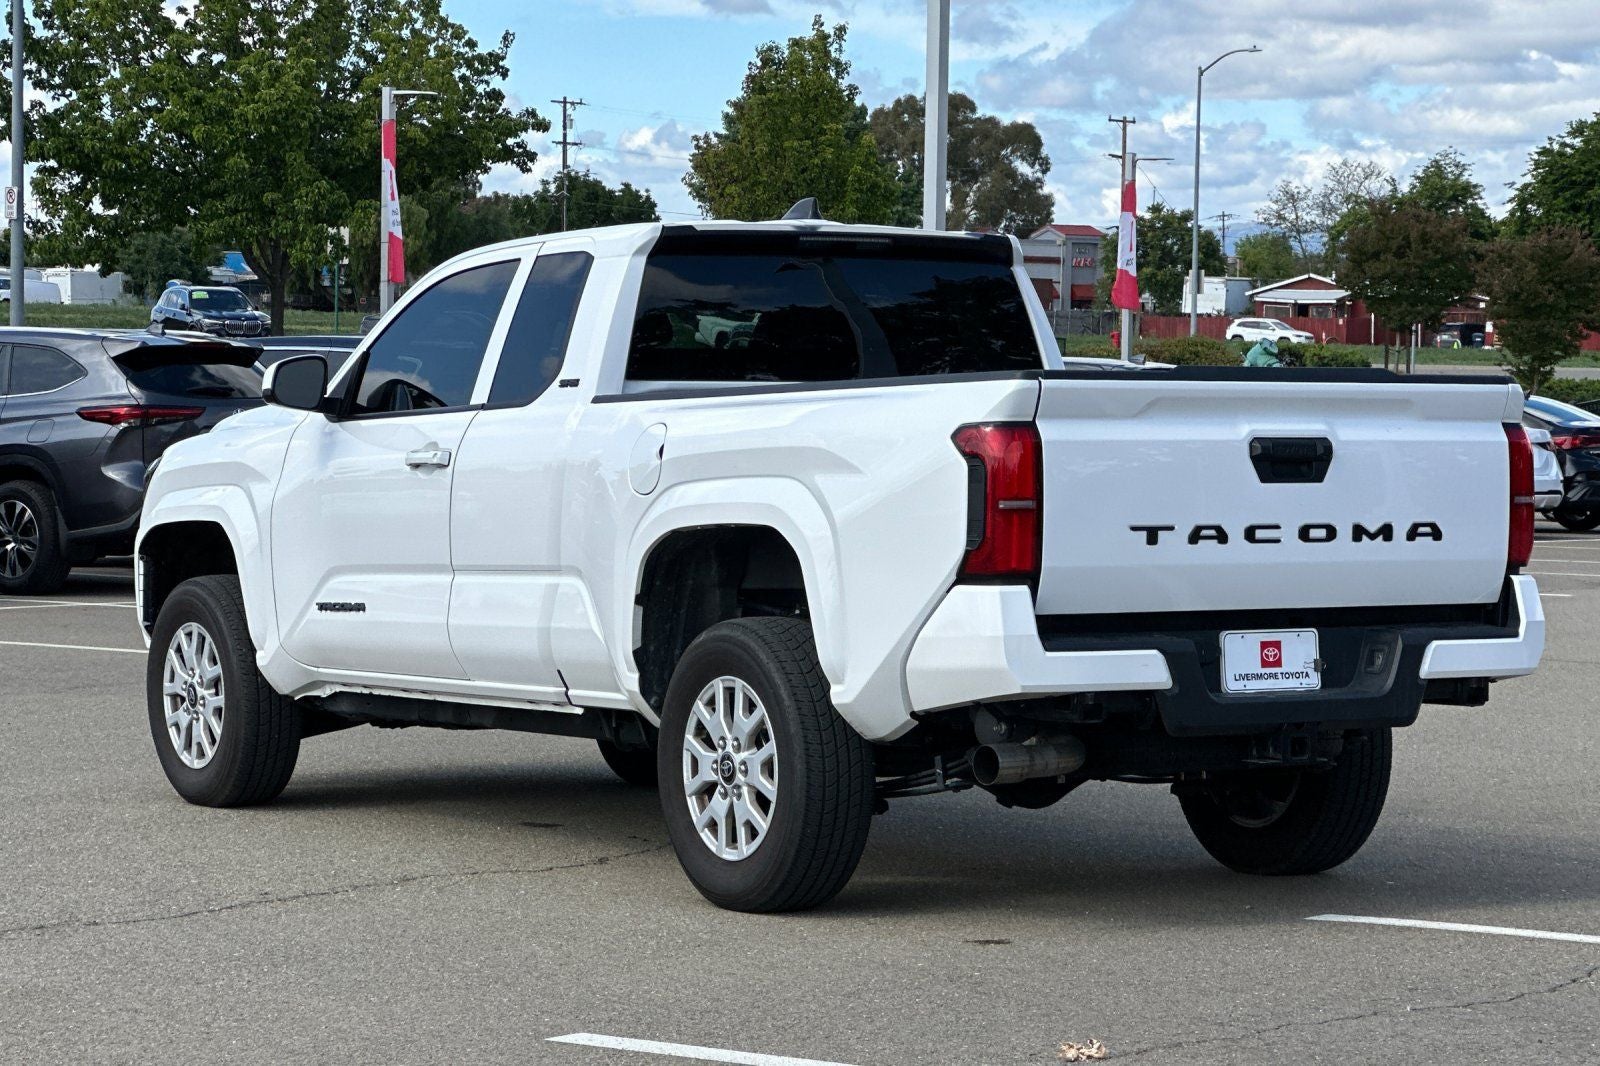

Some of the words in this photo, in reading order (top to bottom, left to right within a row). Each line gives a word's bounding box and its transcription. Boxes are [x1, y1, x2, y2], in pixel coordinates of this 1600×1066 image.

[1129, 522, 1443, 546] TACOMA
[316, 602, 366, 612] TACOMA
[1233, 672, 1279, 682] LIVERMORE
[1280, 671, 1311, 680] TOYOTA
